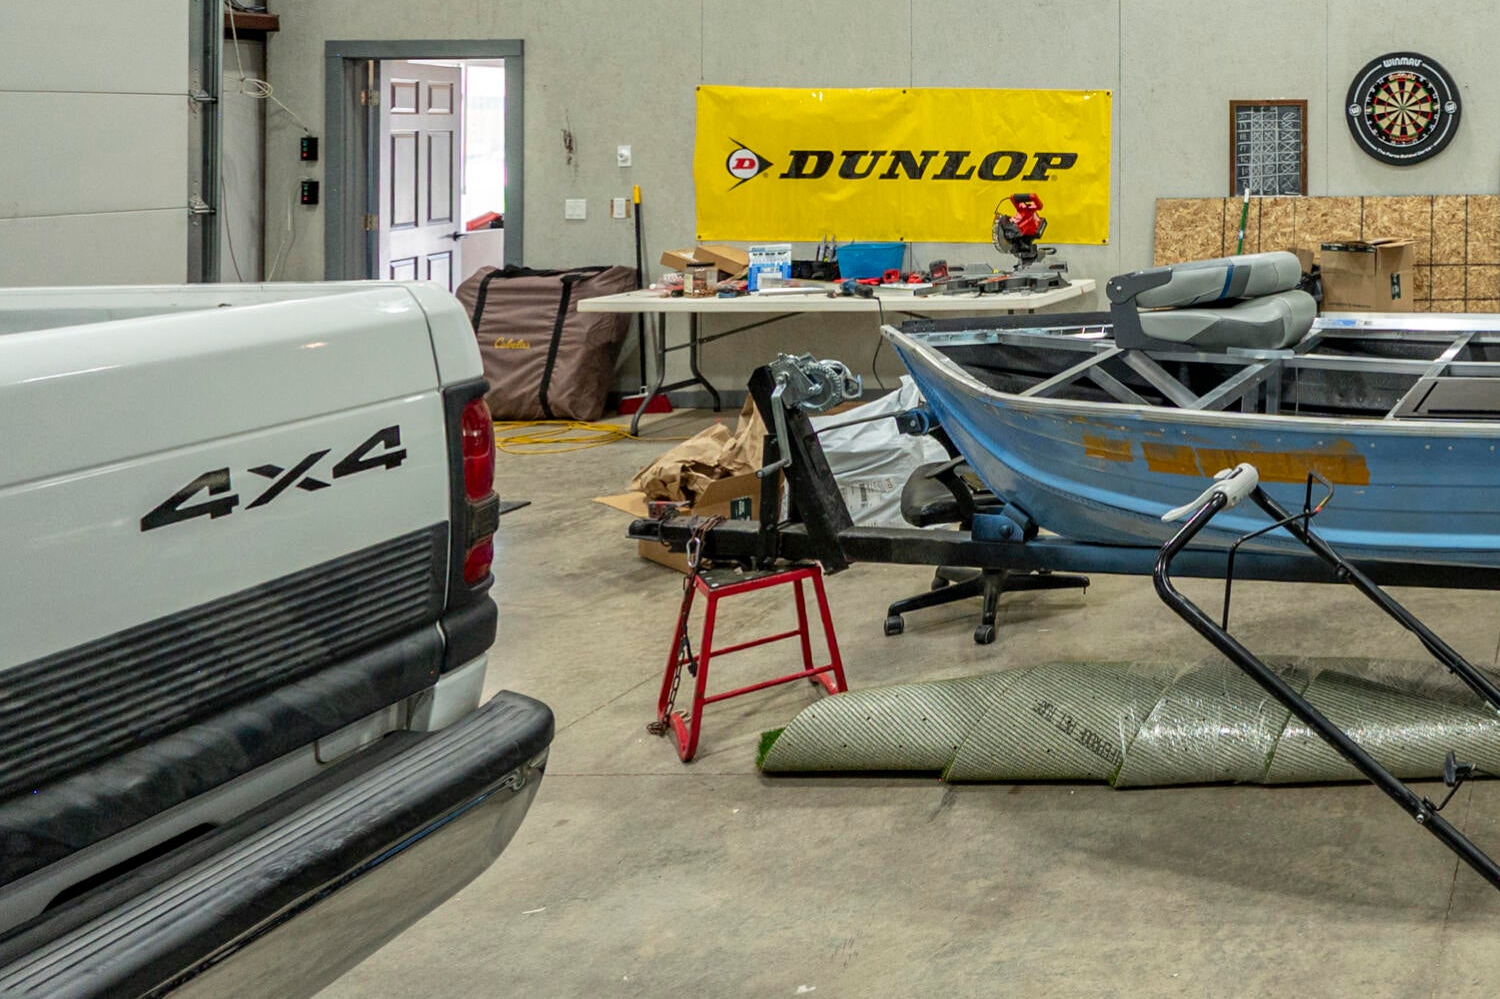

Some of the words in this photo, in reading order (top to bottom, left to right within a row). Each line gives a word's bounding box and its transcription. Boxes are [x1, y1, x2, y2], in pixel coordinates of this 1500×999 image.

[1383, 57, 1422, 68] WINMAU
[731, 158, 757, 170] D
[779, 150, 1078, 181] DUNLOP
